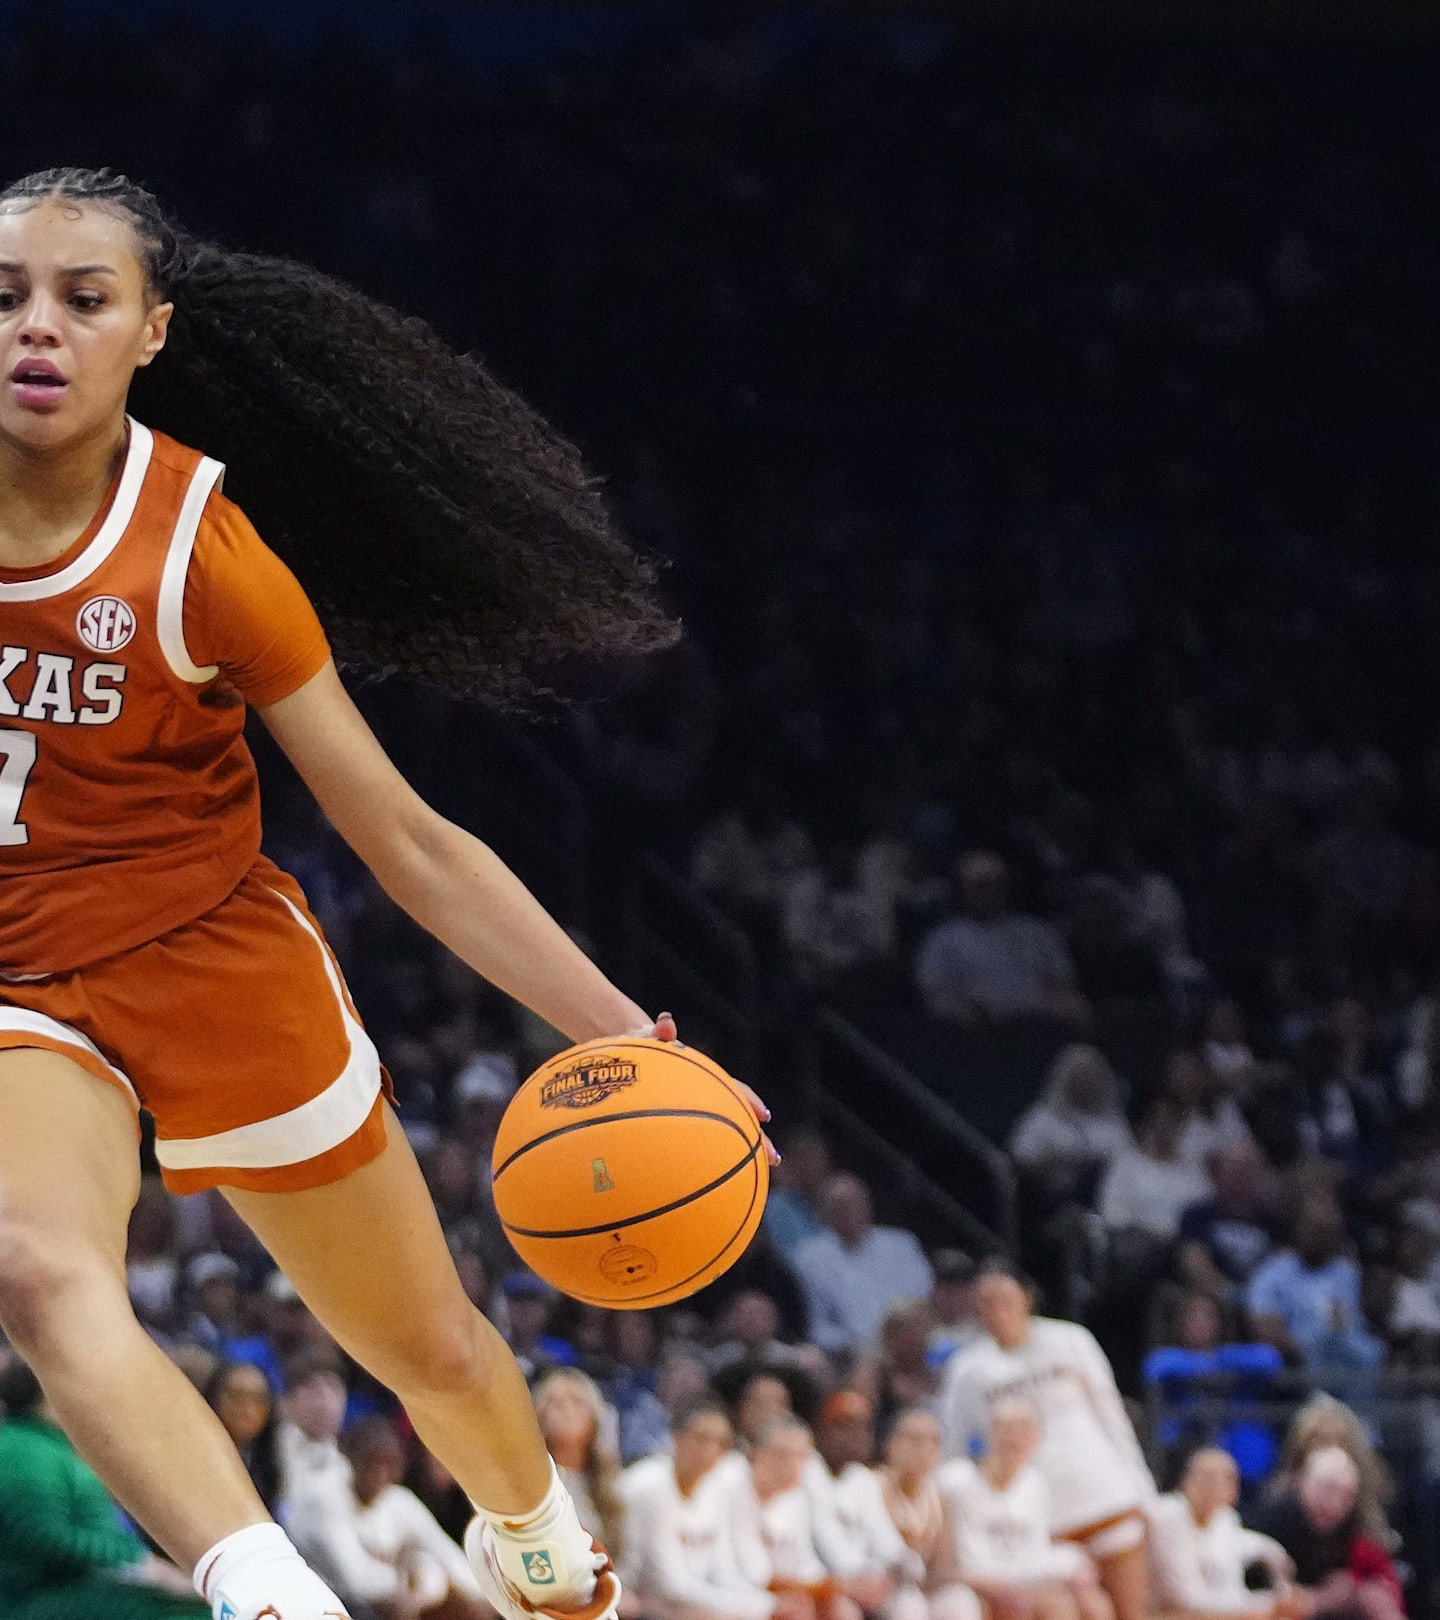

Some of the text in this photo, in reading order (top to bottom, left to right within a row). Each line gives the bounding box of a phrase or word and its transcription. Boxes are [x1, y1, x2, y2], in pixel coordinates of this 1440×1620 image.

[81, 600, 132, 649] SEC
[543, 1073, 585, 1099] FINAL
[588, 1065, 633, 1085] FOUR
